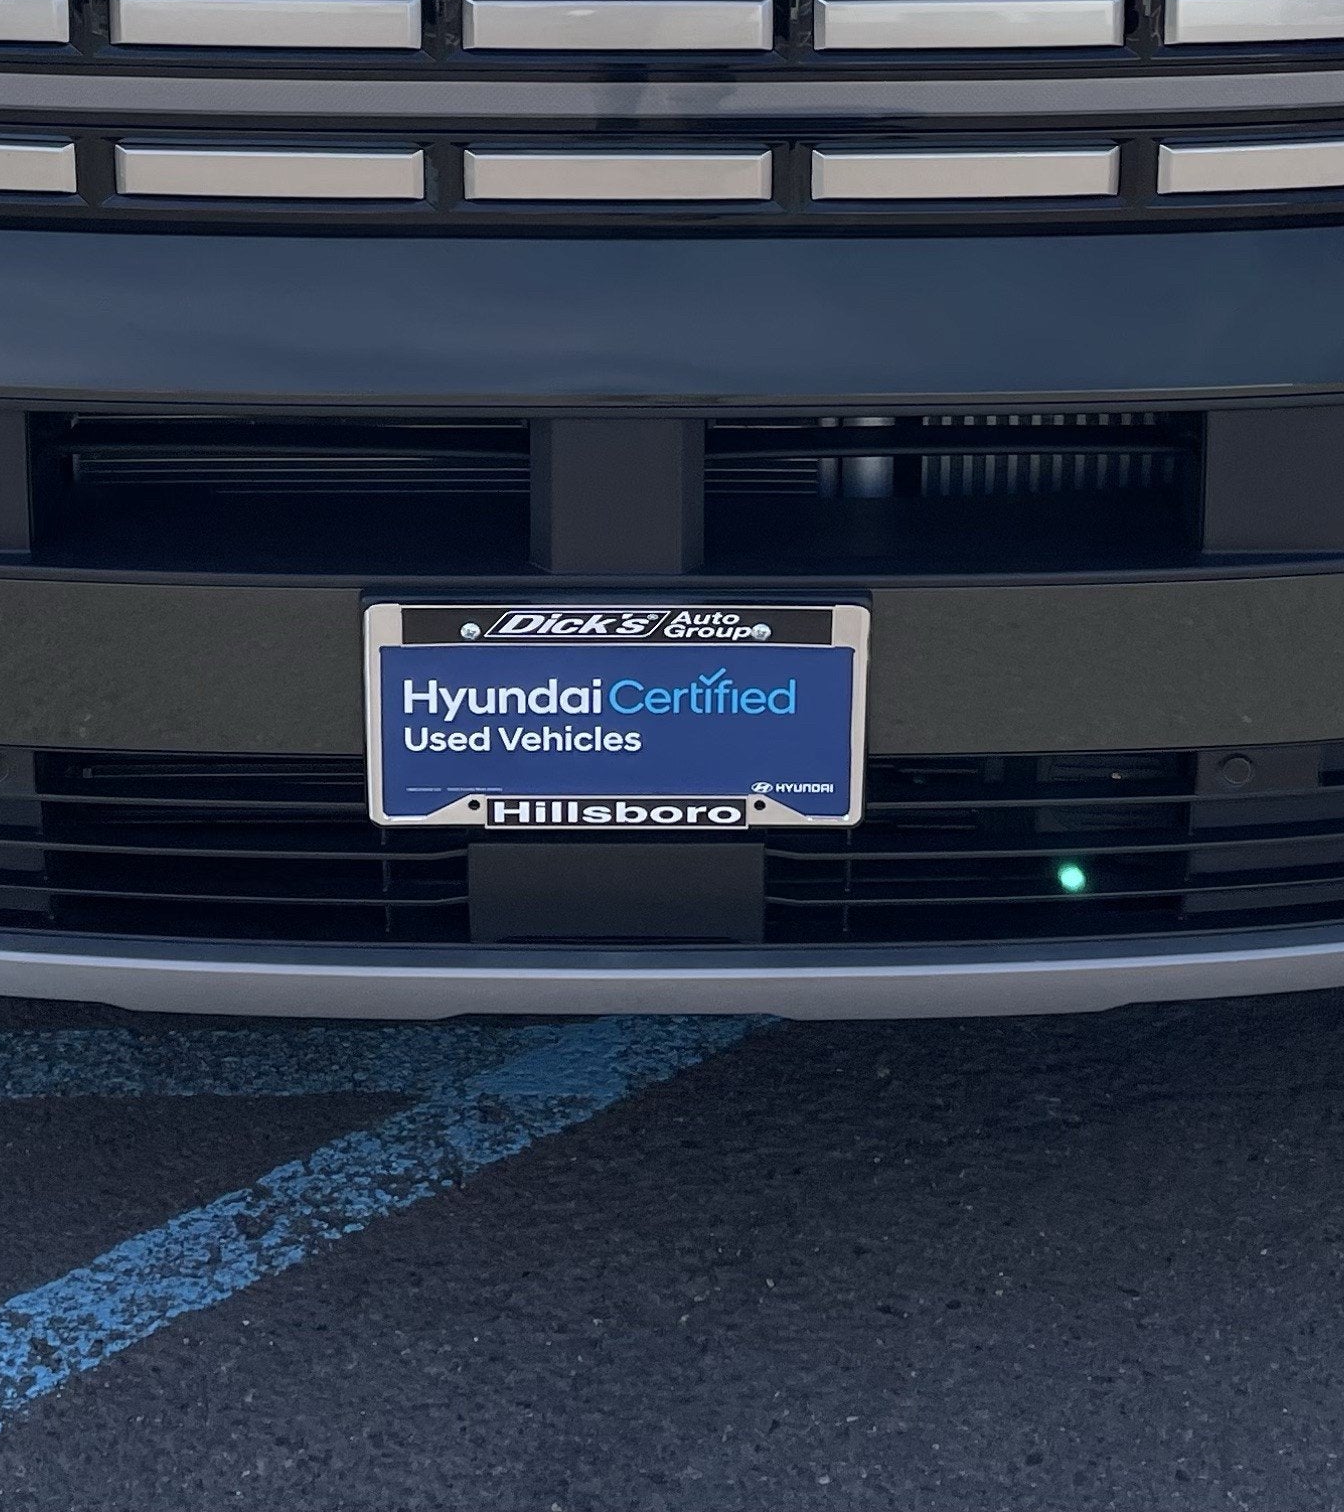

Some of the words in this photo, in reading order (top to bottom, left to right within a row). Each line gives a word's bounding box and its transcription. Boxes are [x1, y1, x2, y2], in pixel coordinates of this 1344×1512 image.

[670, 610, 741, 626] Auto
[663, 623, 751, 641] Group
[403, 678, 603, 722] Hyundai
[609, 675, 797, 715] Certified
[404, 726, 491, 753] Used
[498, 725, 642, 753] Vehicles
[775, 783, 834, 793] HYUNDAI
[493, 801, 743, 824] Hillsboro
